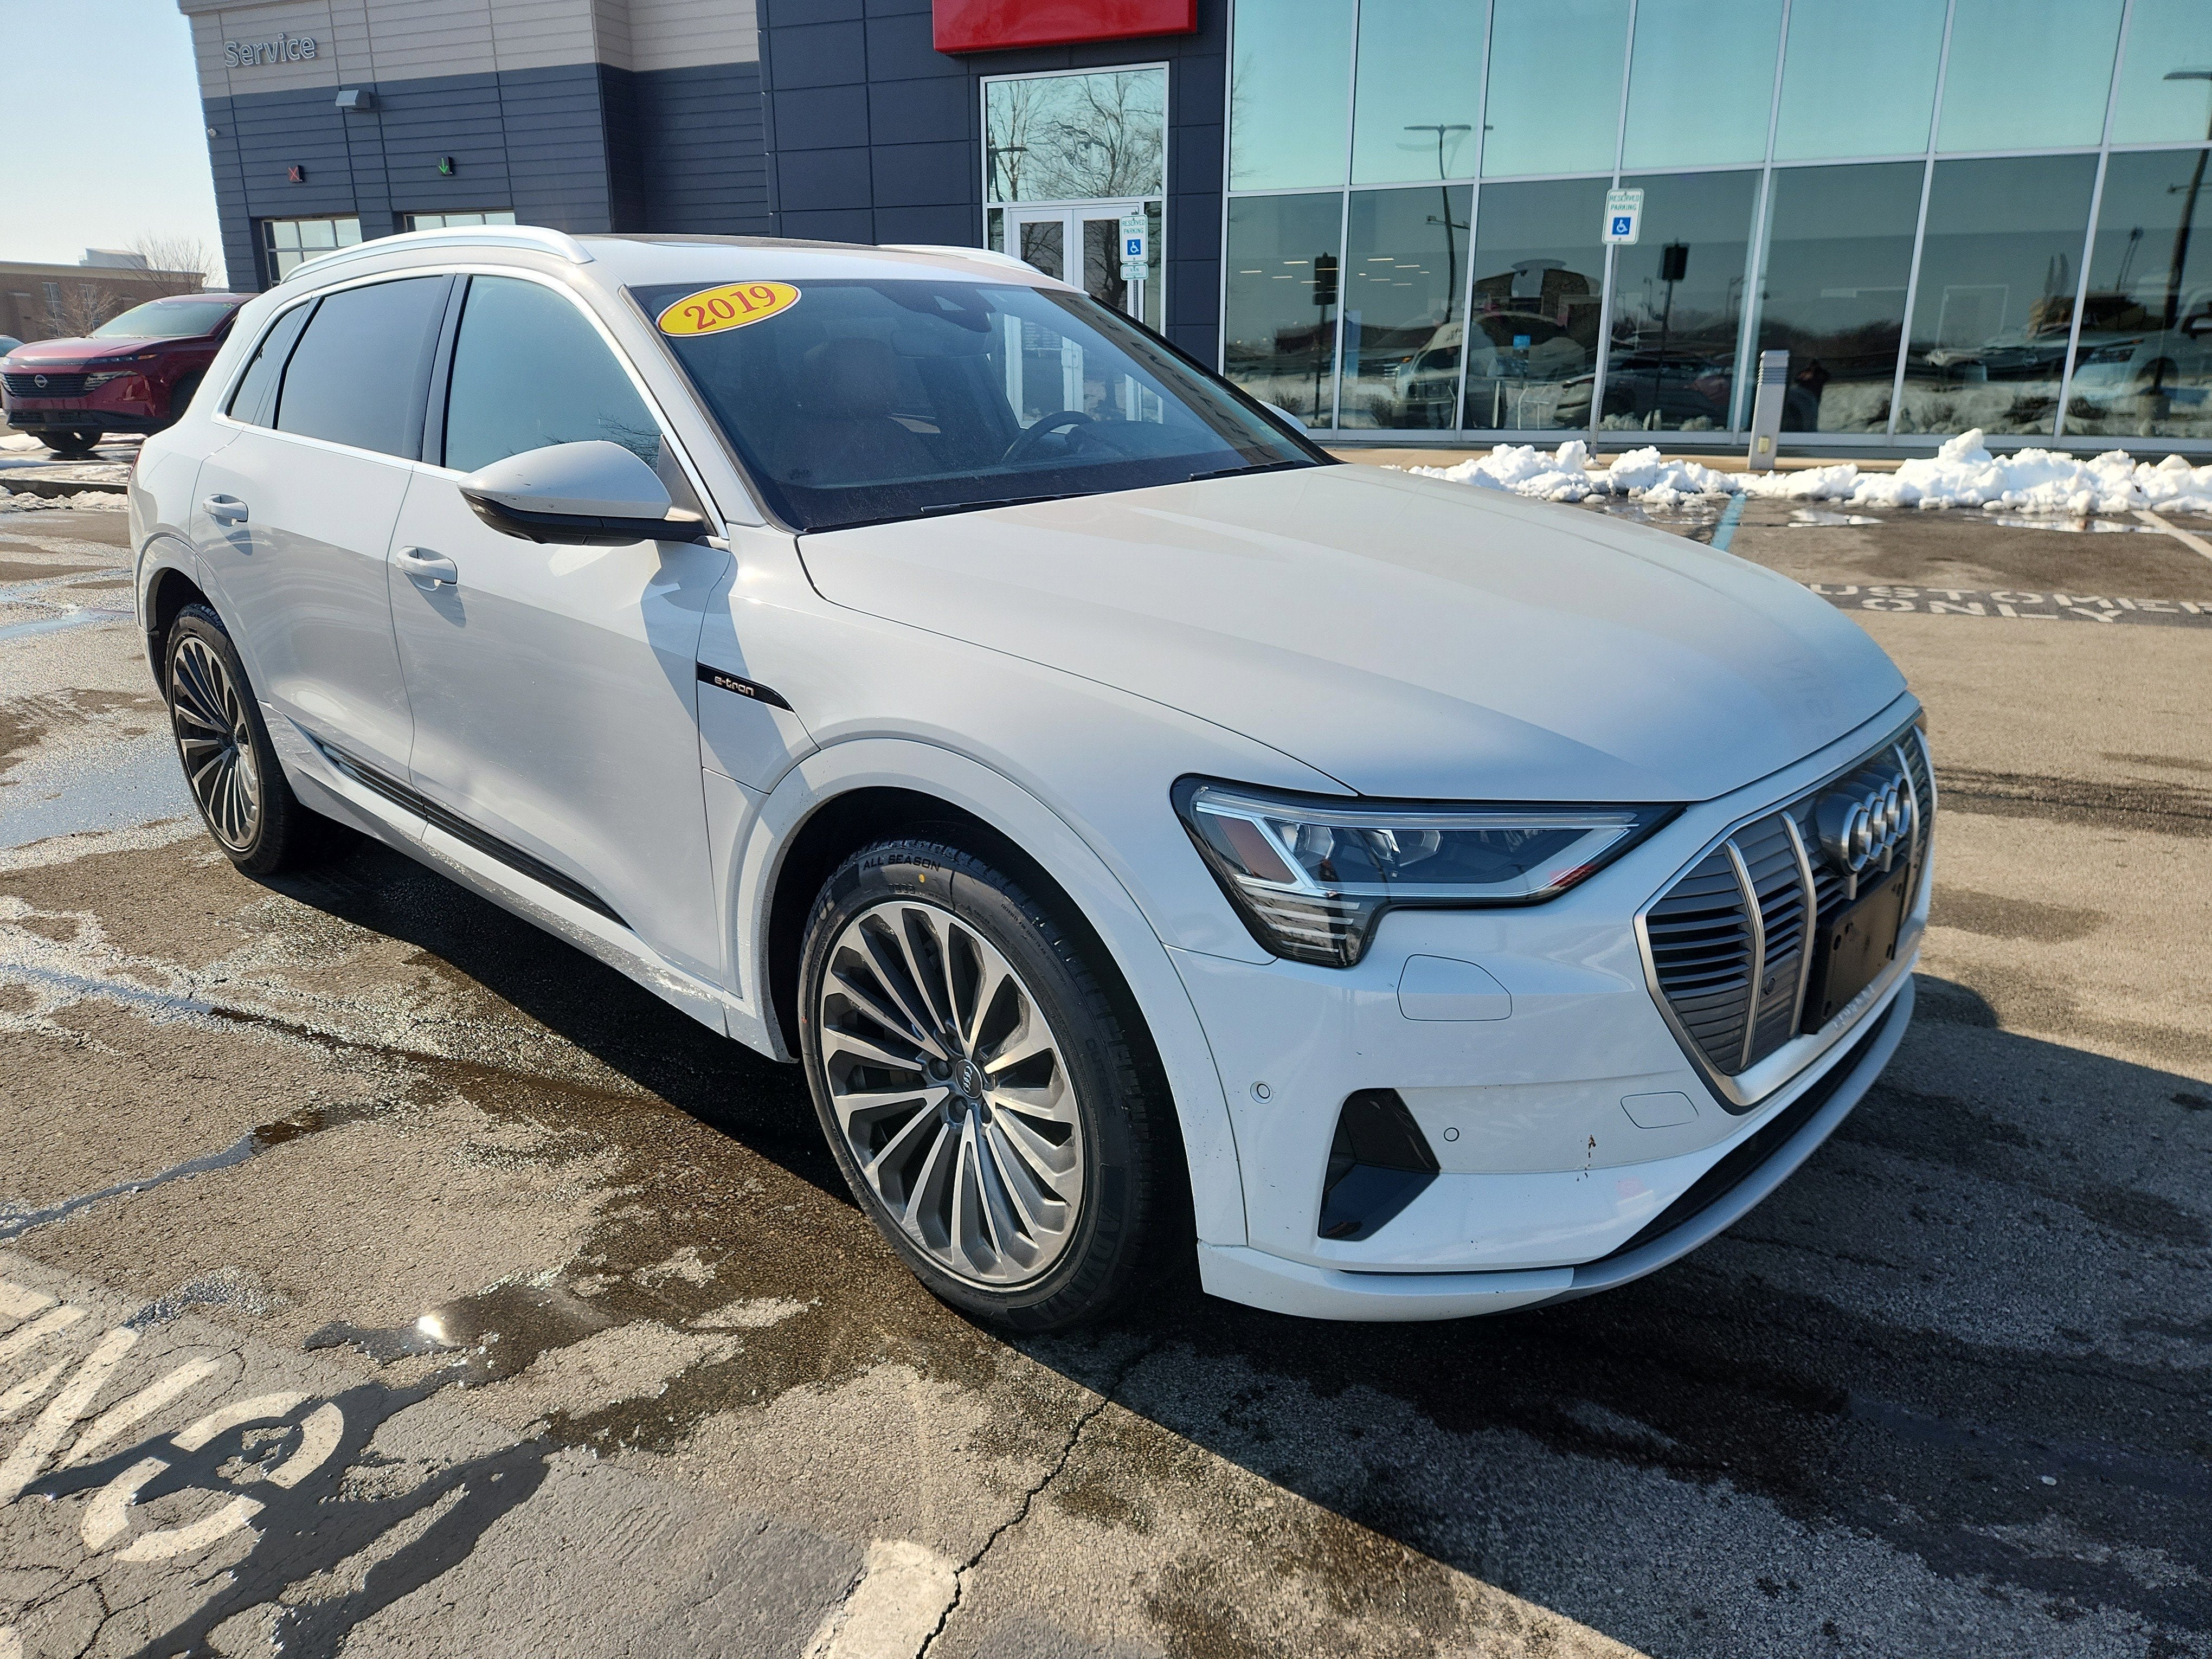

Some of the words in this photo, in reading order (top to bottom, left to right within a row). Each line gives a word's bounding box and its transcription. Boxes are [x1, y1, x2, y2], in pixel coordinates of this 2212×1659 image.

[223, 33, 314, 67] Service
[684, 285, 776, 330] 2019
[1809, 583, 2212, 614] USTOMER
[1861, 598, 2123, 623] ONLY
[714, 676, 755, 696] e-tron
[863, 856, 884, 871] ALL
[888, 854, 941, 872] SEASON
